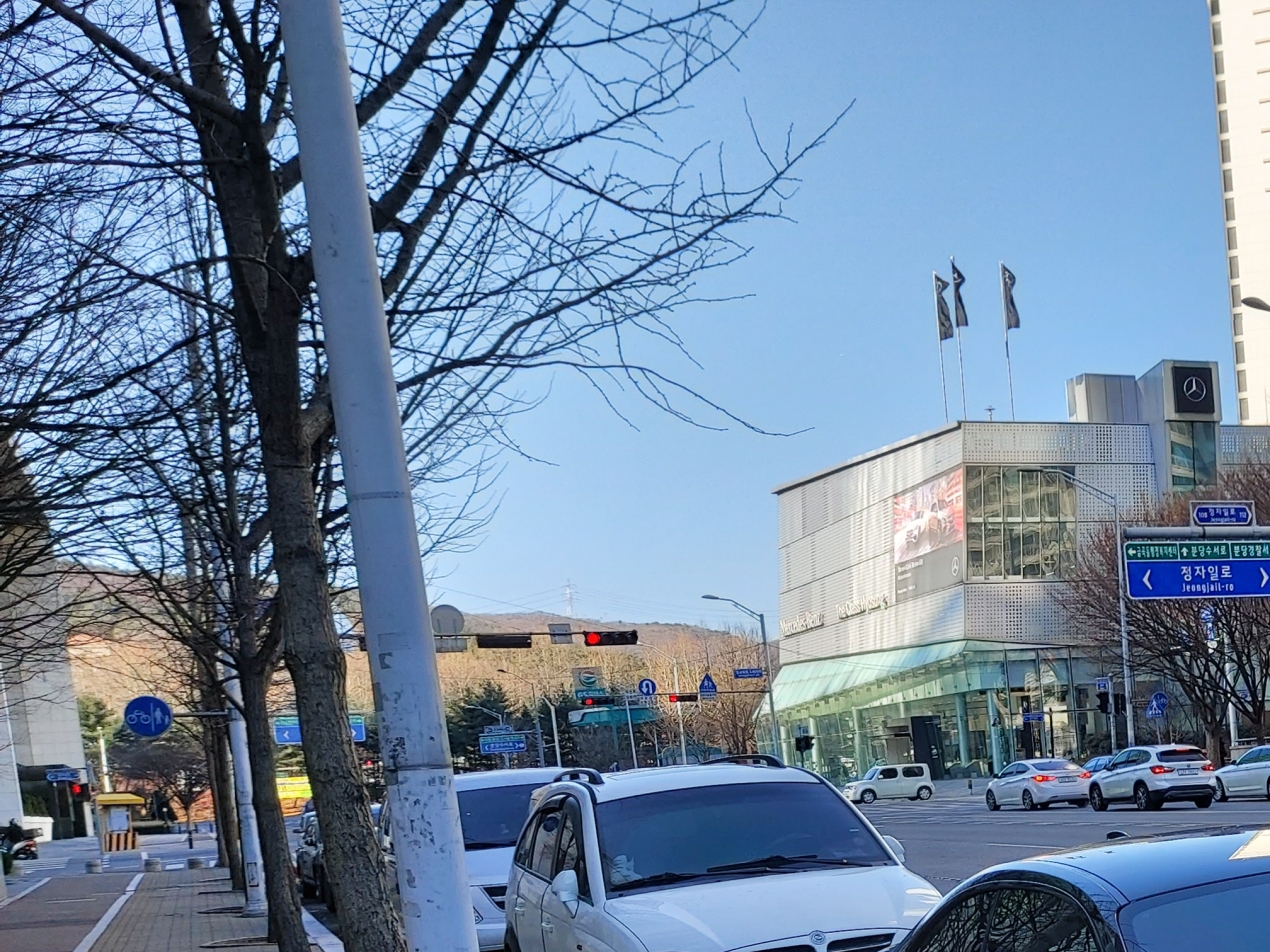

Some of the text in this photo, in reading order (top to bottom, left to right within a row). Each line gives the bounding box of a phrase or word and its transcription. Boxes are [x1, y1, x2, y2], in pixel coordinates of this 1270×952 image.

[1209, 508, 1236, 517] 정자일로
[1191, 545, 1227, 557] 분당수서로
[1233, 544, 1270, 557] 분당경찰서
[1180, 565, 1233, 581] 정자일로
[1182, 582, 1235, 594] Jeongjail-ro
[780, 611, 825, 637] Mercedes-Benz
